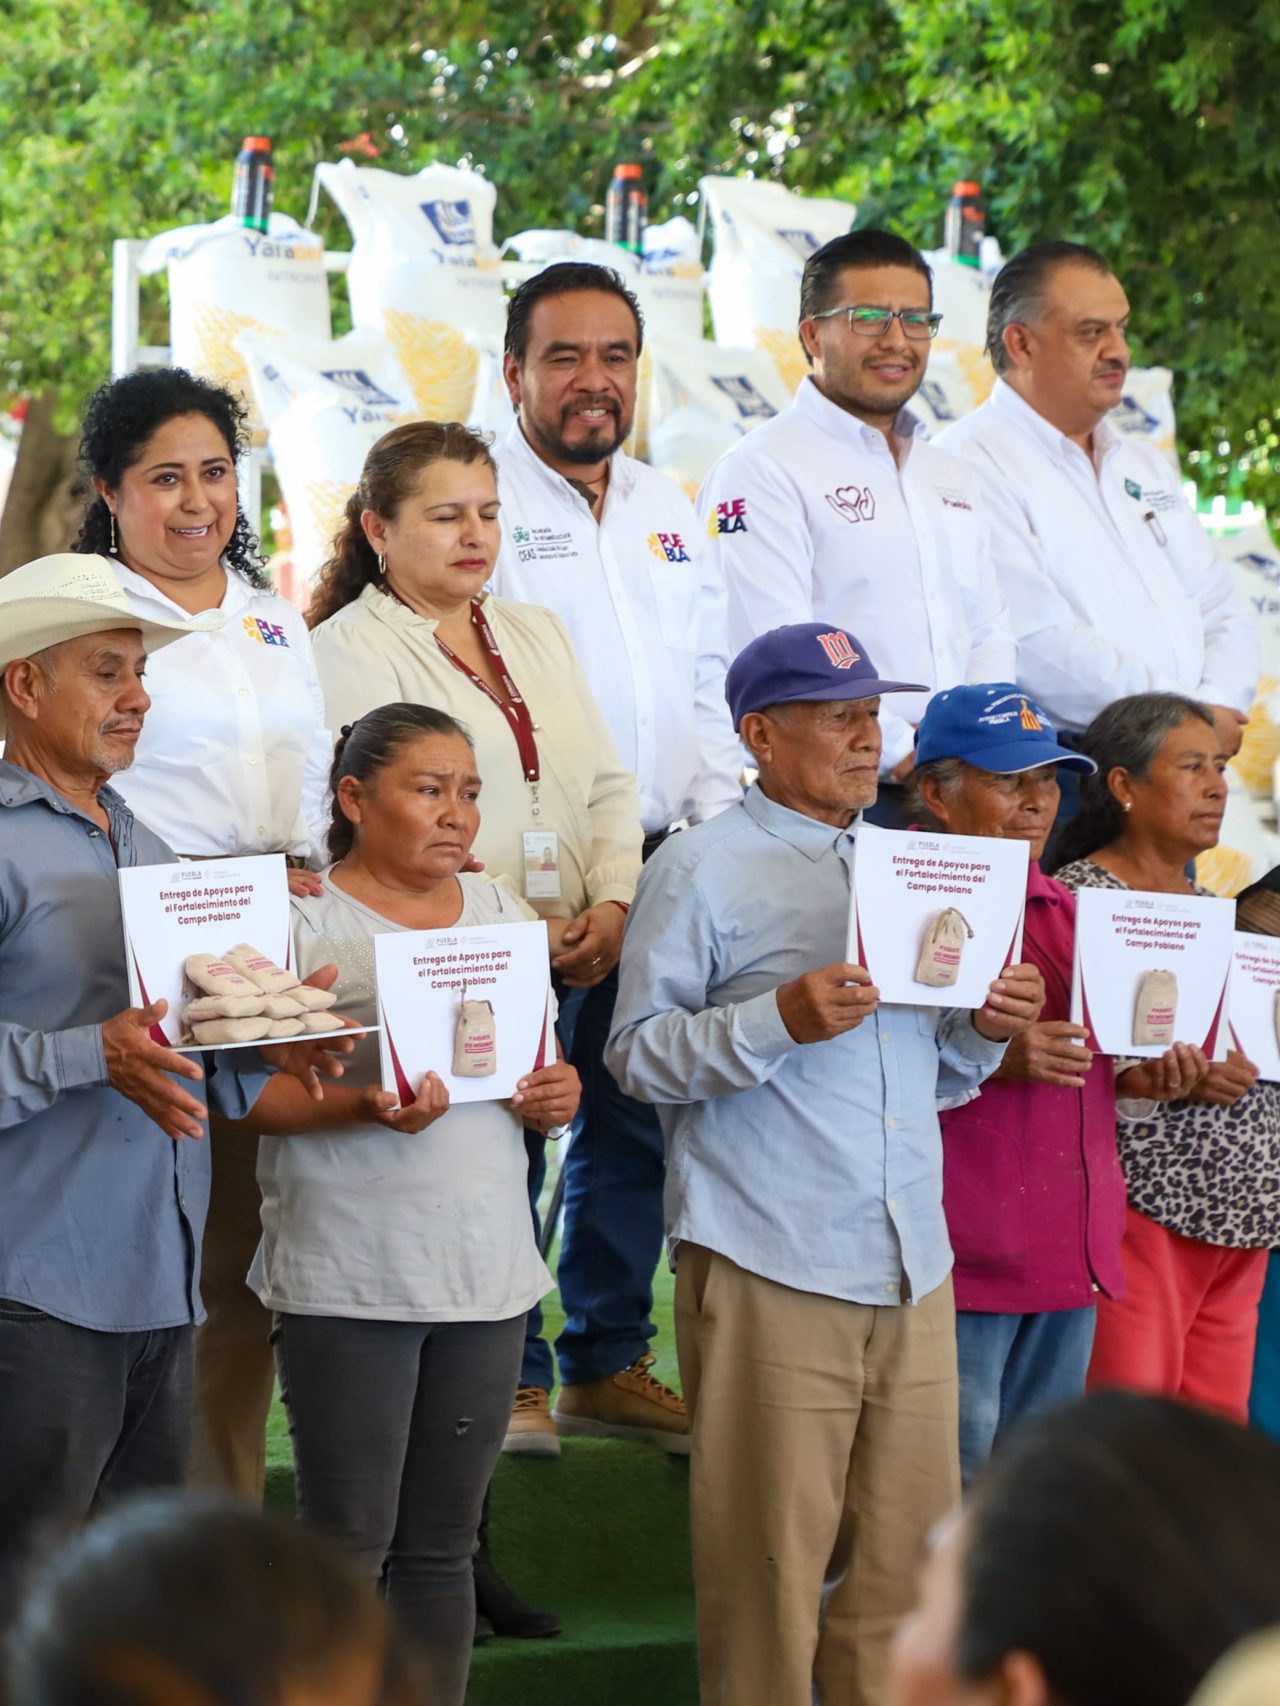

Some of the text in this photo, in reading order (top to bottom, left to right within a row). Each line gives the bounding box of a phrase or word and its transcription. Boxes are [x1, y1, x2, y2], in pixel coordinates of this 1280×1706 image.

[893, 856, 990, 872] Entrega de Apoyos para
[896, 869, 985, 882] el Fortalecimiento del
[160, 884, 254, 900] Entrega de Apoyos para
[907, 882, 972, 894] Campo Poblano
[165, 898, 250, 912] el Fortalecimiento del
[178, 912, 240, 925] Campo Poblano
[1112, 915, 1201, 929] Entrega de Apoyos para
[1115, 926, 1196, 939] el Fortalecimiento del
[1125, 939, 1184, 950] Campo Poblano
[413, 951, 511, 966] Entrega de Apoyos para
[418, 962, 507, 977] el Fortalecimiento del
[431, 978, 461, 989] Campo
